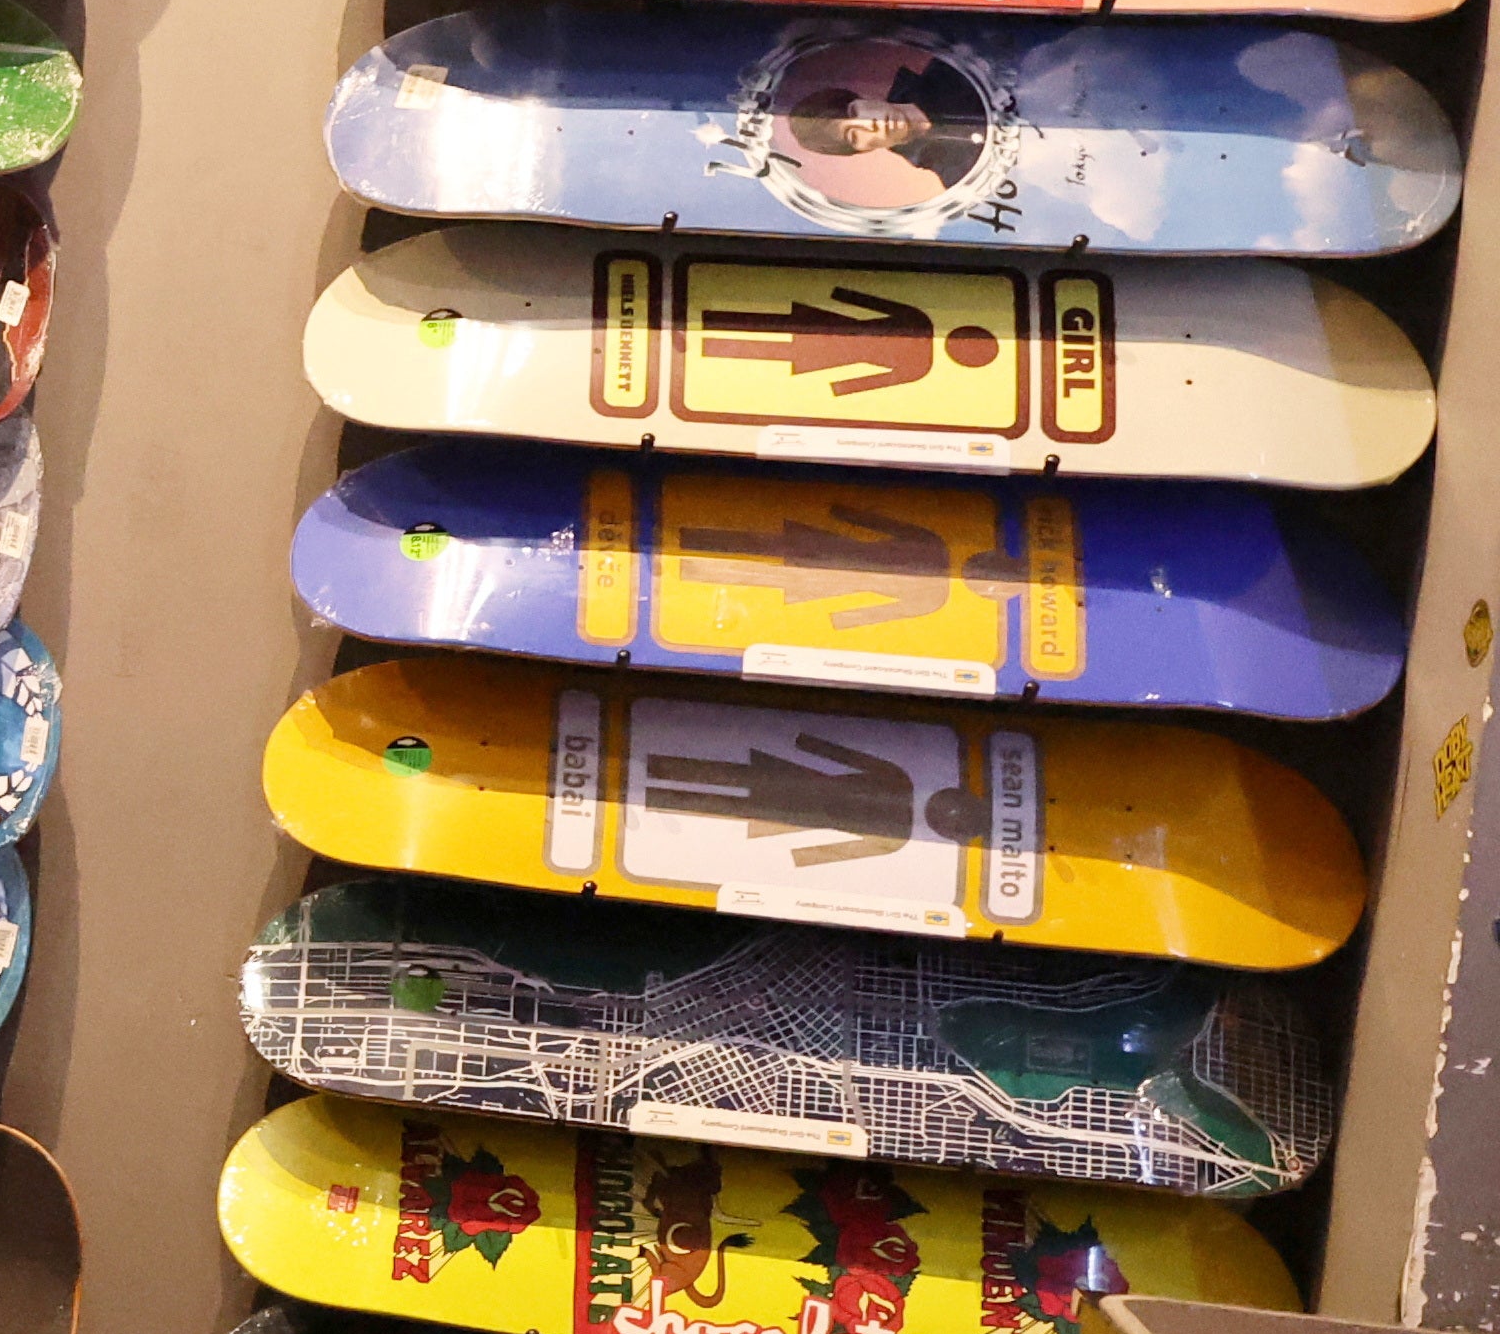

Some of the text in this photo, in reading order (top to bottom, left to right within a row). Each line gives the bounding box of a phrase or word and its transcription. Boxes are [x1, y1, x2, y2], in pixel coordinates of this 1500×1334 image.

[1061, 308, 1096, 399] GIRL
[1000, 748, 1025, 900] sean malto
